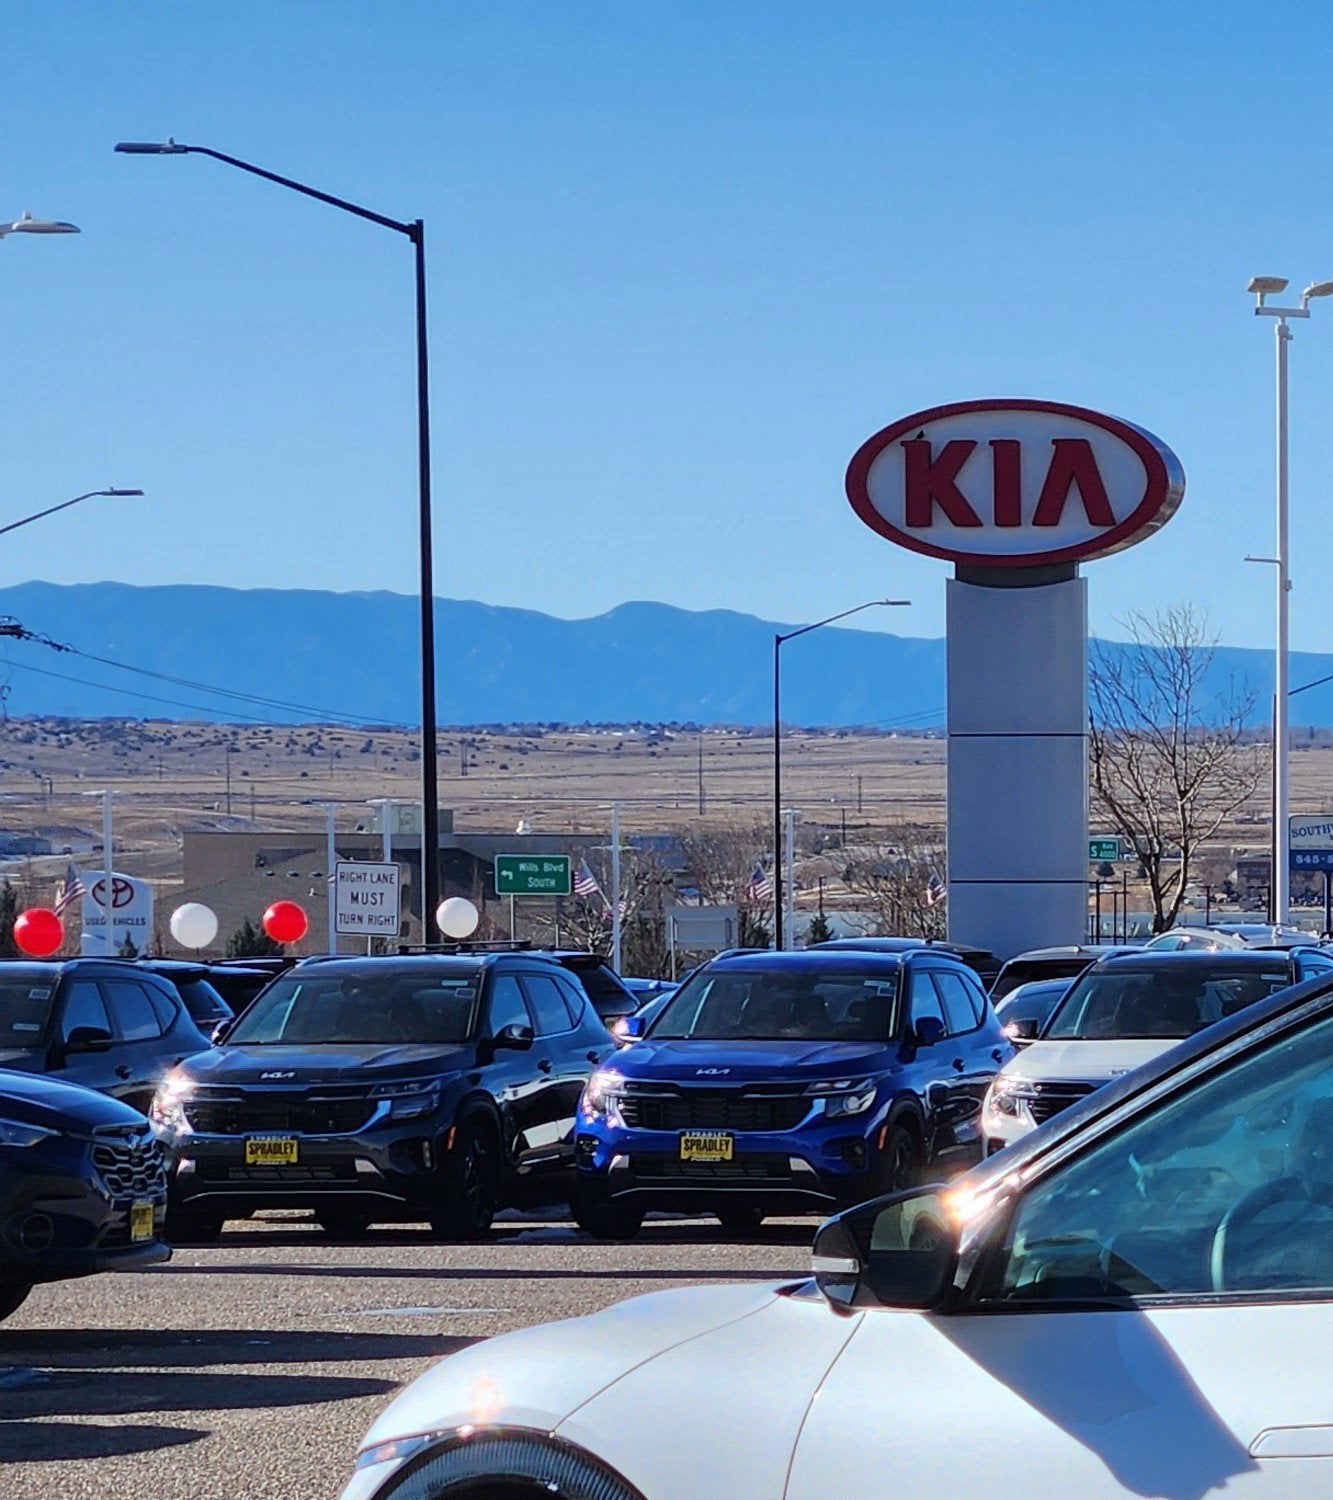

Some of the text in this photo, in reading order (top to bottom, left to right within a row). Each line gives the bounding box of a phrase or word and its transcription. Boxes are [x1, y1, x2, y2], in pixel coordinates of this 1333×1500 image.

[900, 437, 1117, 527] KIA
[543, 862, 564, 873] Blvd
[339, 871, 396, 885] RIGHT LANE
[350, 891, 385, 906] MUST
[339, 913, 396, 926] TURN RIGHT
[684, 1138, 730, 1152] SPRADLEY
